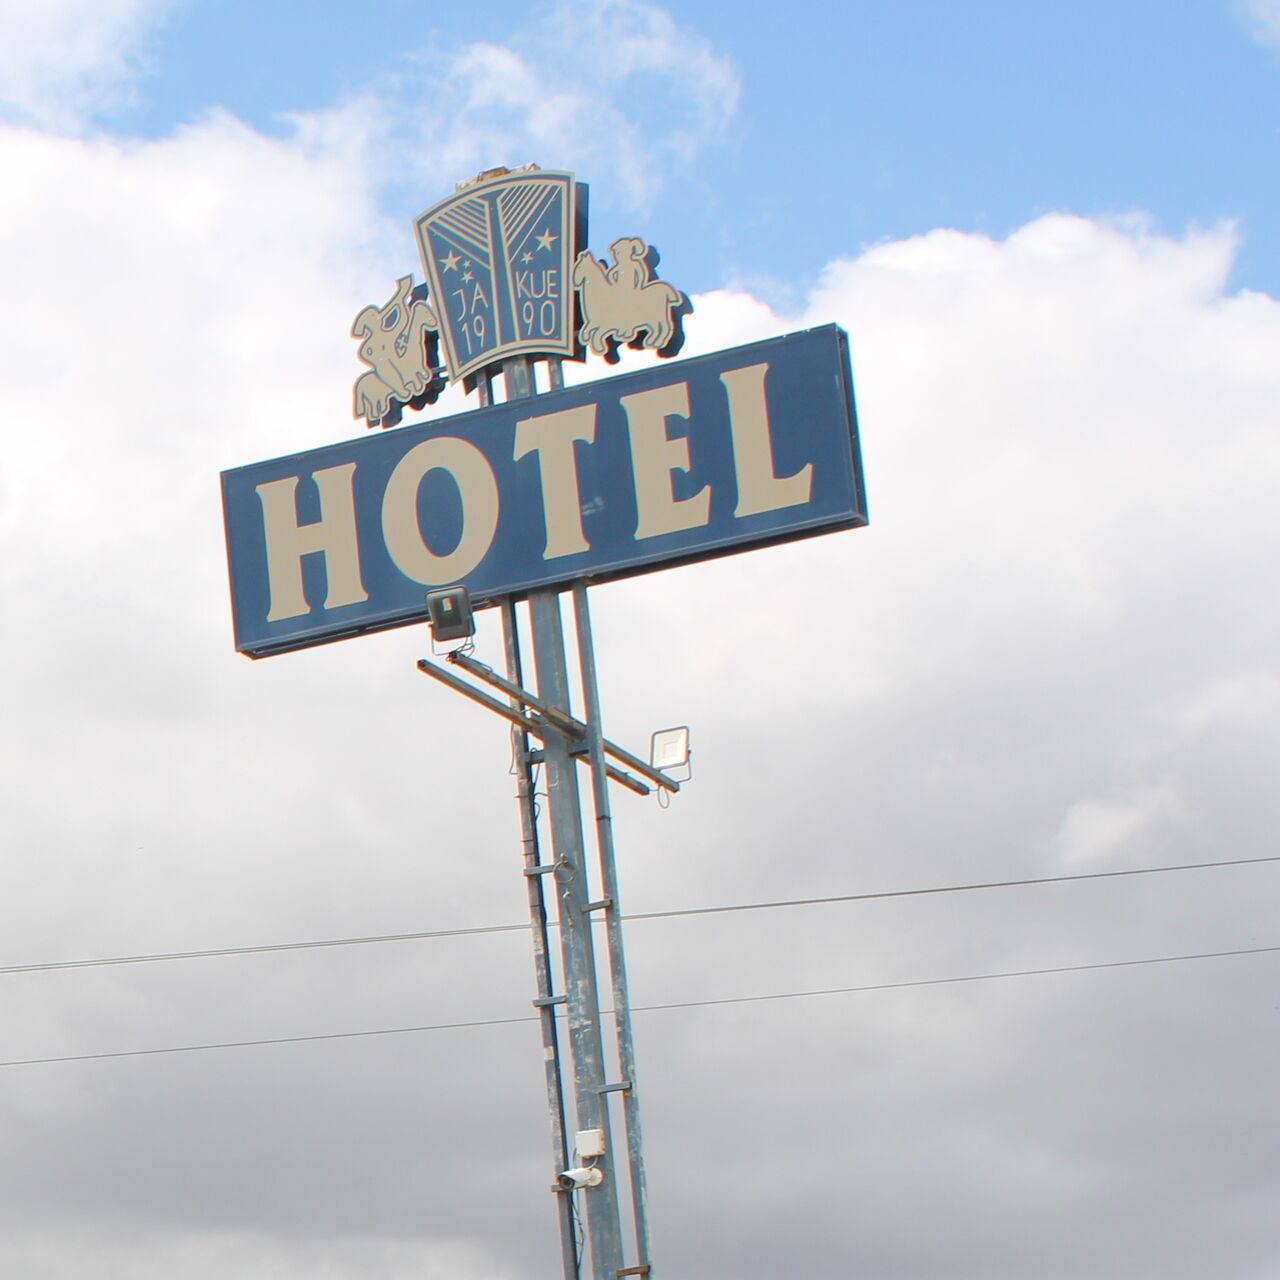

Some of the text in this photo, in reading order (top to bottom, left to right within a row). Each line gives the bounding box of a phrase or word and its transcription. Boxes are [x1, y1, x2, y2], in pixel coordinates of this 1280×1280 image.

[515, 269, 559, 299] KUE
[460, 300, 556, 355] 19 90
[254, 361, 814, 624] HOTEL
